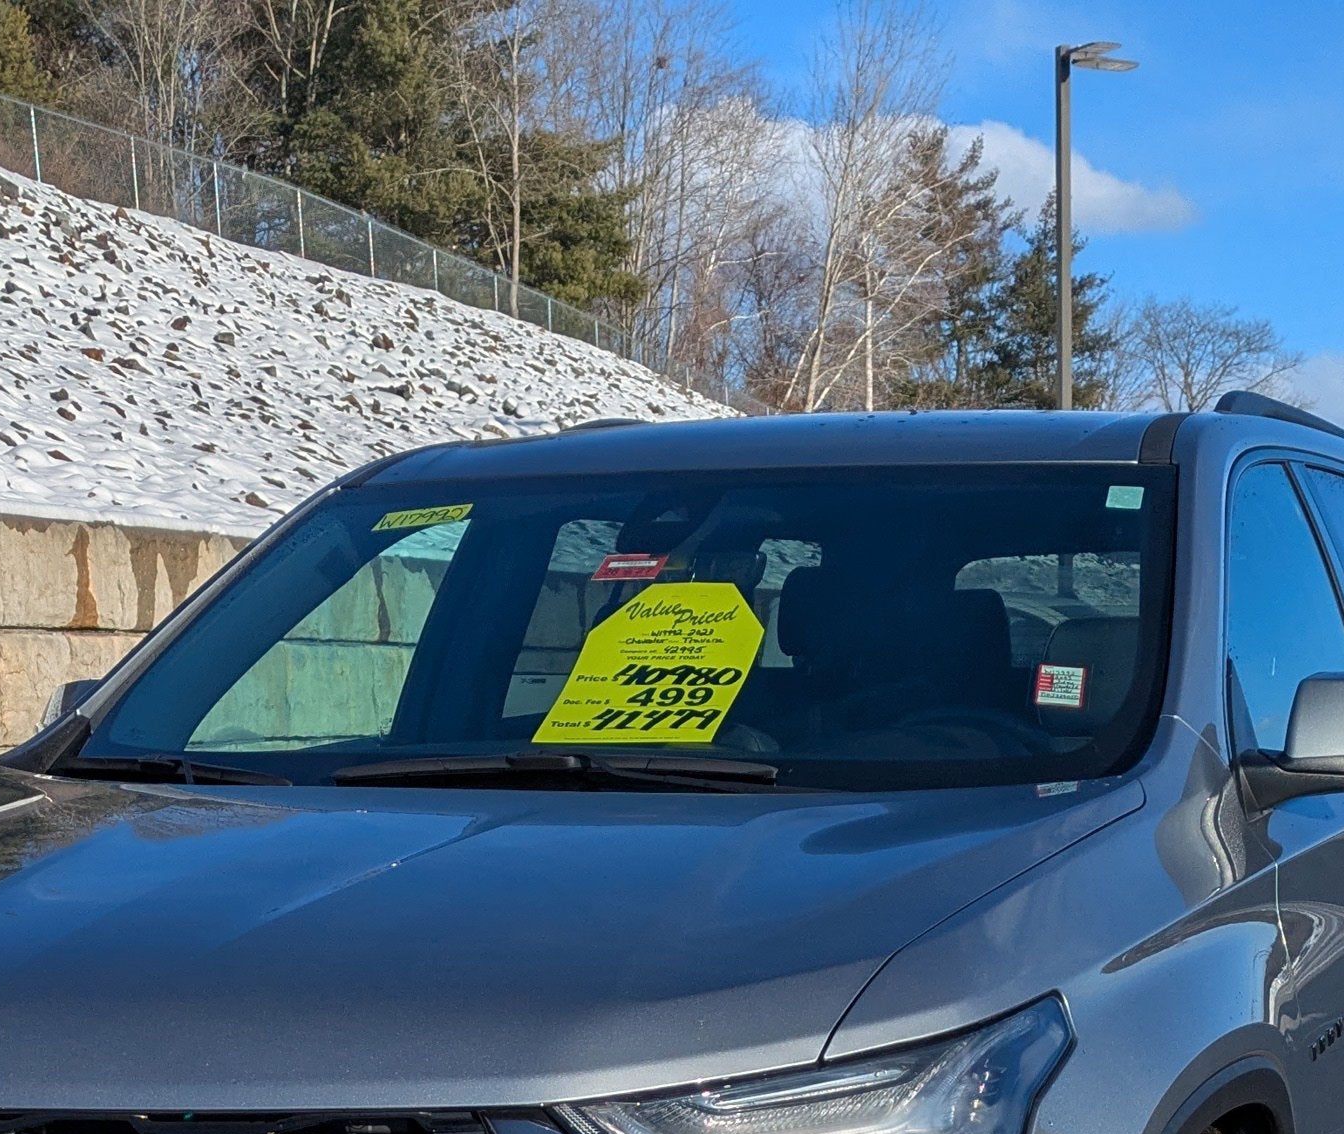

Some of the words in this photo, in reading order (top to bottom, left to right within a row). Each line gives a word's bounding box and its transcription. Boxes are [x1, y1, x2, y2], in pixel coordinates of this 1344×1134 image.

[626, 600, 682, 620] Value
[672, 605, 739, 629] Priced
[664, 646, 706, 654] 42995
[576, 674, 607, 682] Price
[614, 663, 743, 687] 40980
[626, 687, 714, 707] 499
[551, 720, 581, 728] Total
[591, 708, 723, 731] 41479
